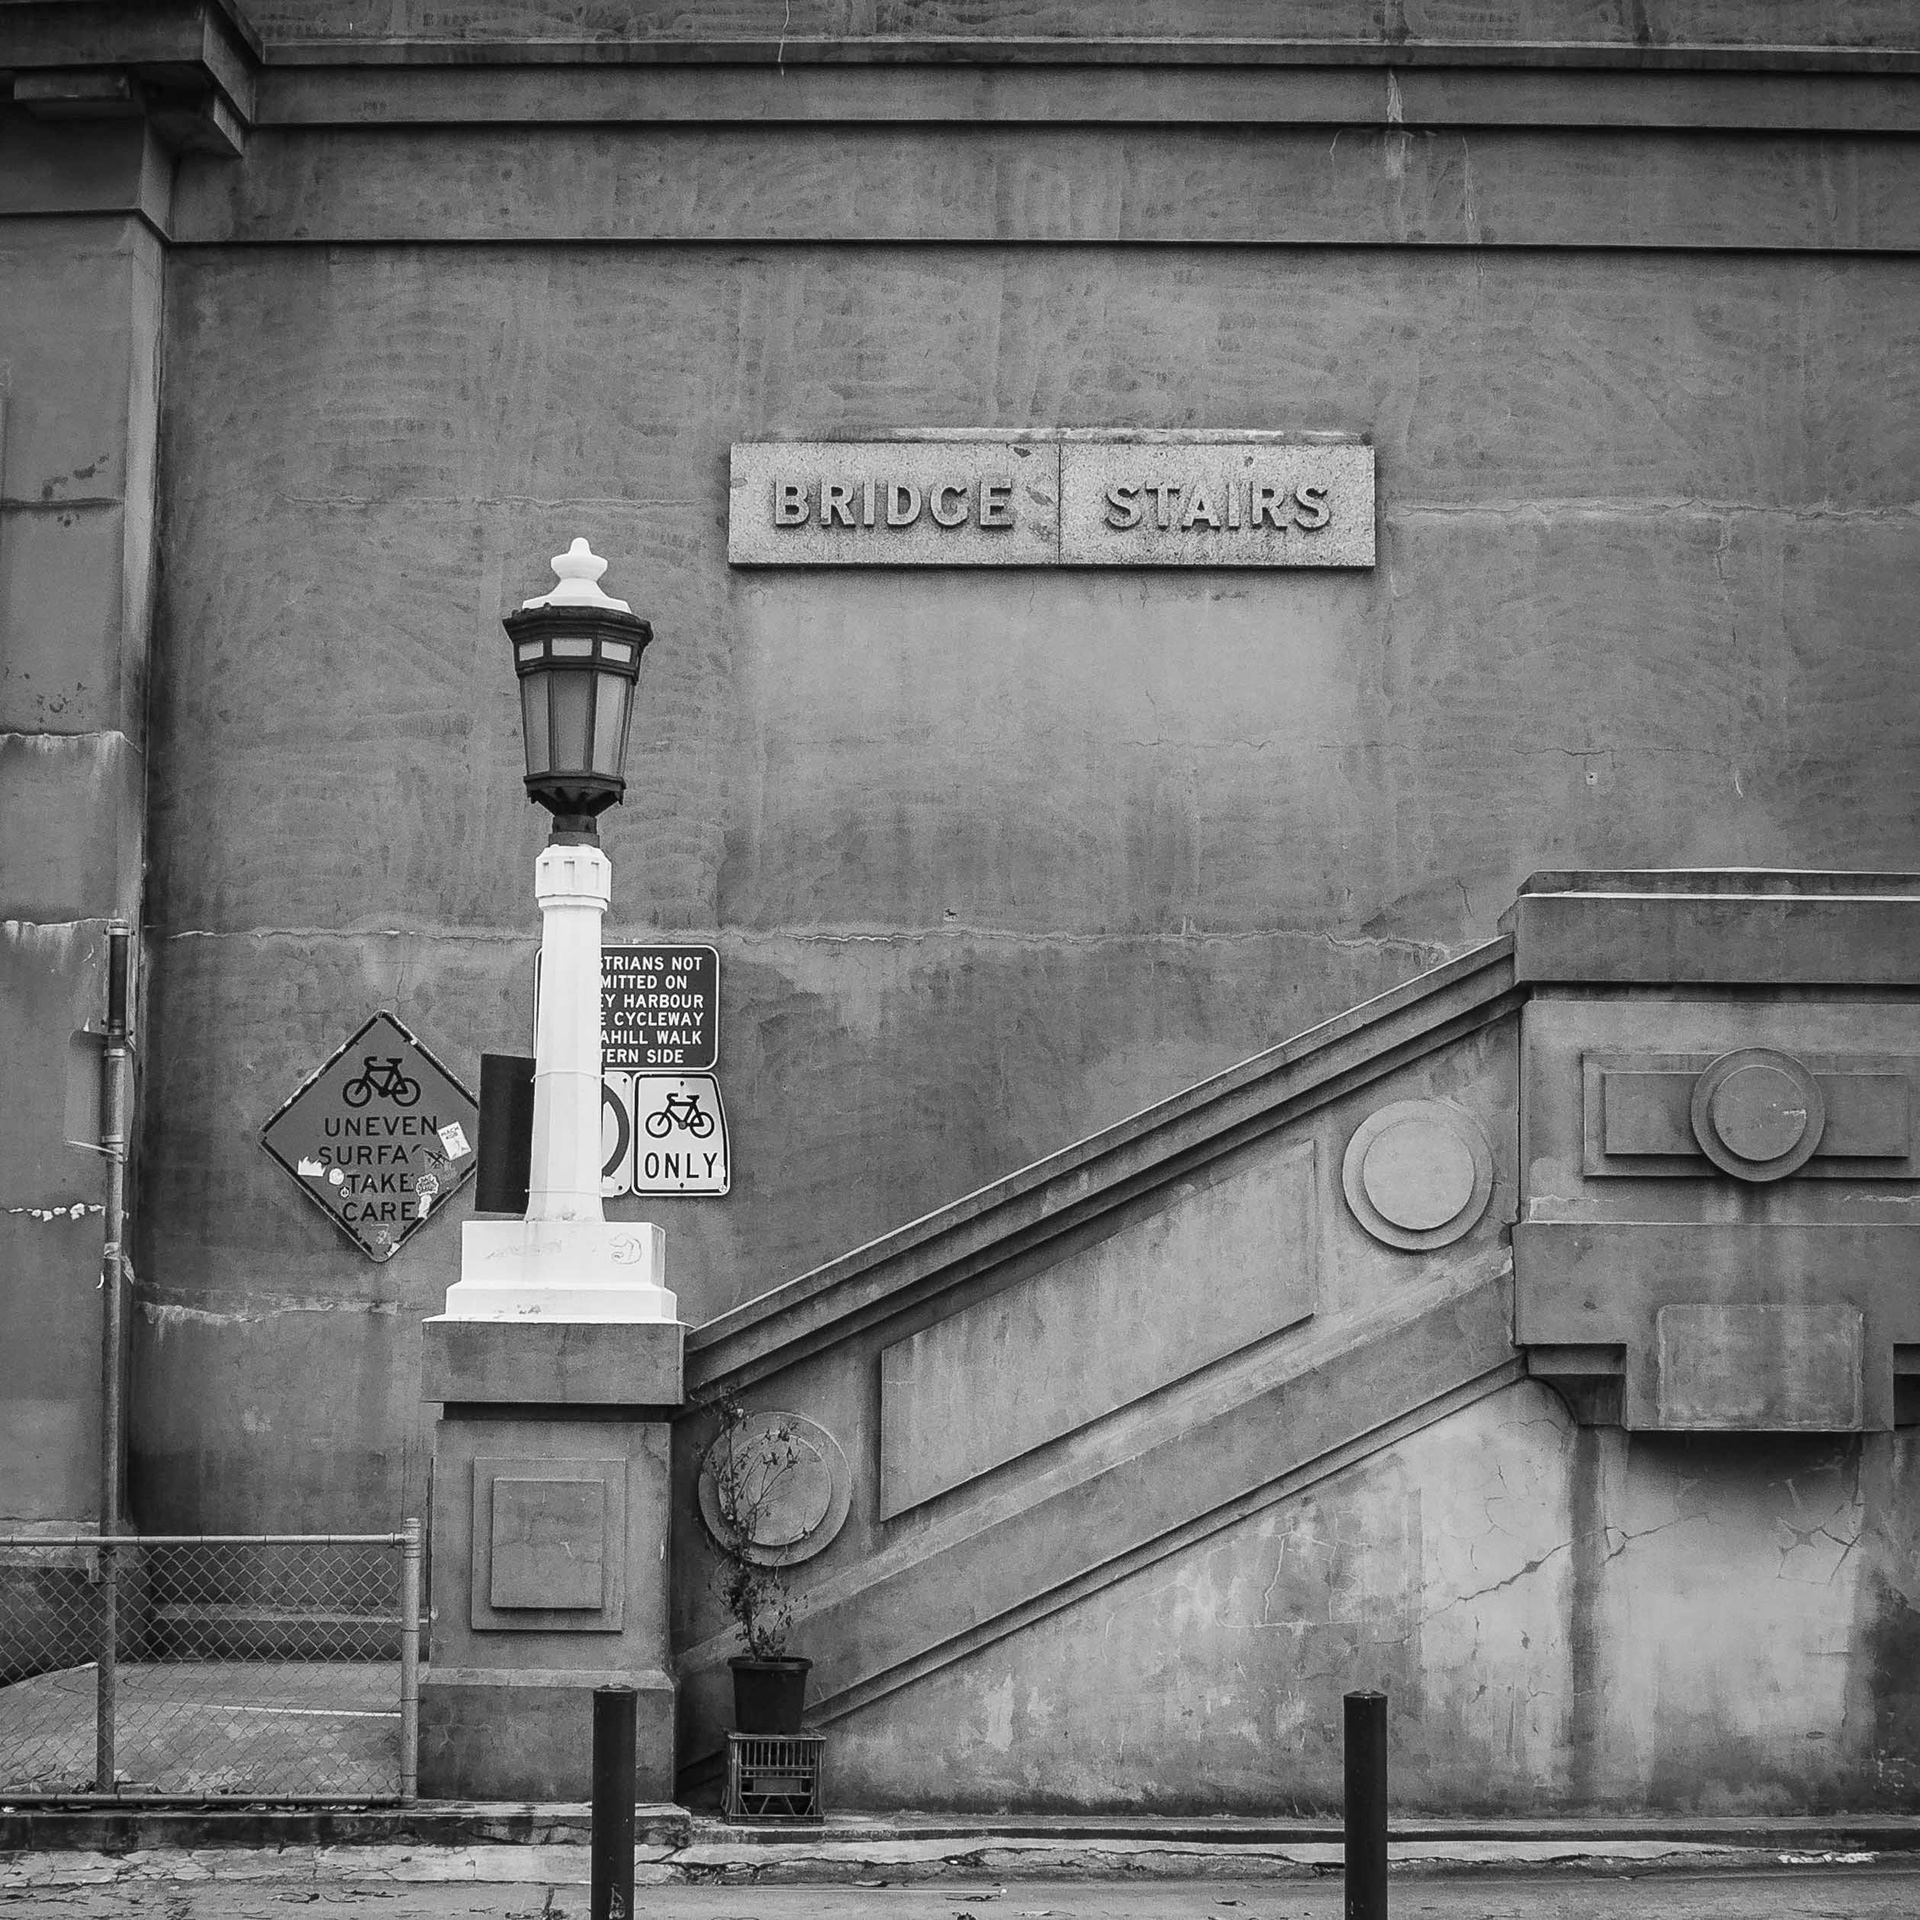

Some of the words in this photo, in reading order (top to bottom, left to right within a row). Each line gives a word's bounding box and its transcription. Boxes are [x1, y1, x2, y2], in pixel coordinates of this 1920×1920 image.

[774, 479, 1014, 529] BRIDGE
[1103, 480, 1332, 532] STAIRS
[672, 956, 703, 971] NOT
[665, 975, 687, 989] ON
[624, 994, 704, 1008] HARBOUR
[614, 1011, 704, 1026] CYCLEWAY
[656, 1030, 702, 1045] WALK
[646, 1049, 684, 1064] SIDE
[324, 1115, 437, 1137] UNEVEN
[318, 1143, 422, 1166] SURFA
[644, 1152, 718, 1179] ONLY
[346, 1173, 414, 1194] TAKE
[342, 1201, 417, 1222] CARE
